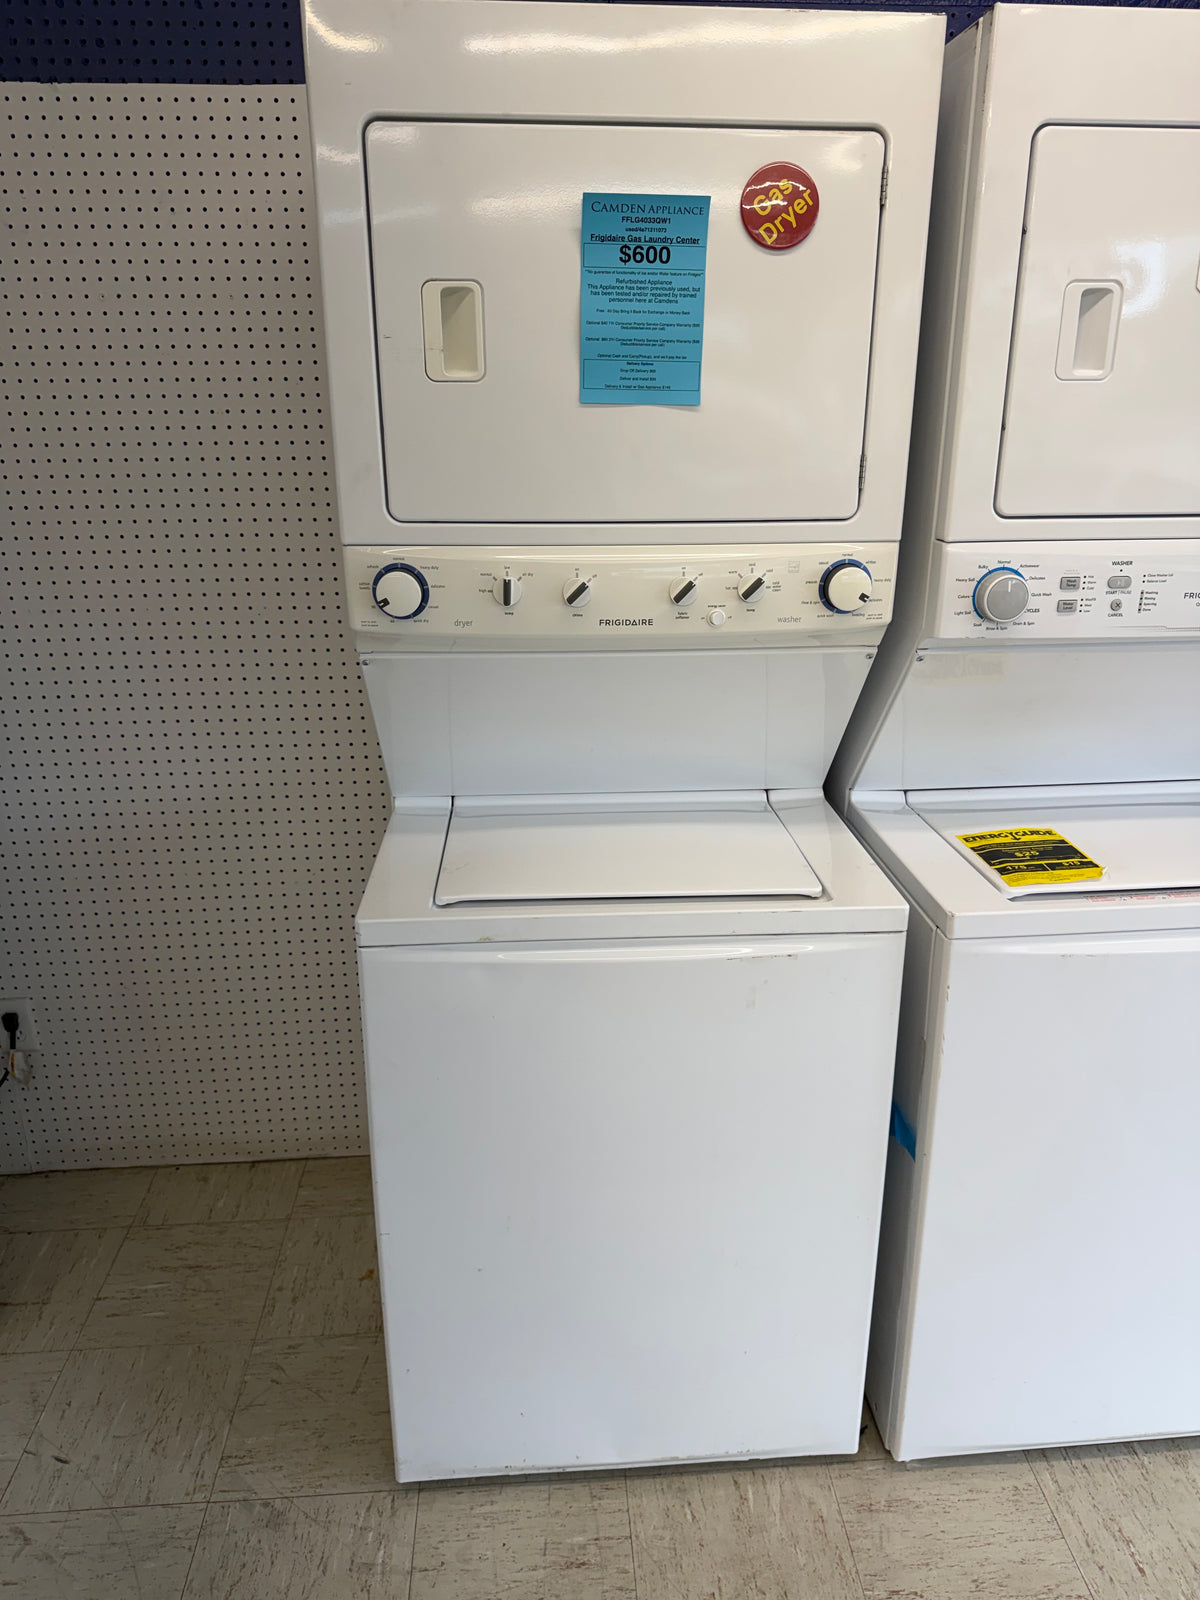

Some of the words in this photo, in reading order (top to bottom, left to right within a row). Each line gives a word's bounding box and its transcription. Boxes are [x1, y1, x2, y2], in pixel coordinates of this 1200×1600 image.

[754, 179, 793, 216] Gas
[591, 201, 646, 214] CAMDEN
[648, 204, 704, 216] APPLIANCE
[621, 216, 671, 224] FFLG4033QW1
[758, 189, 813, 245] Dryer
[590, 233, 625, 243] Frigidaire
[627, 235, 642, 243] Gas
[644, 235, 674, 245] Laundry
[676, 236, 700, 245] Center
[619, 244, 671, 265] $600
[647, 278, 673, 286] Appliance
[454, 618, 474, 628] dryer
[599, 618, 654, 627] FRIGIDAIRE
